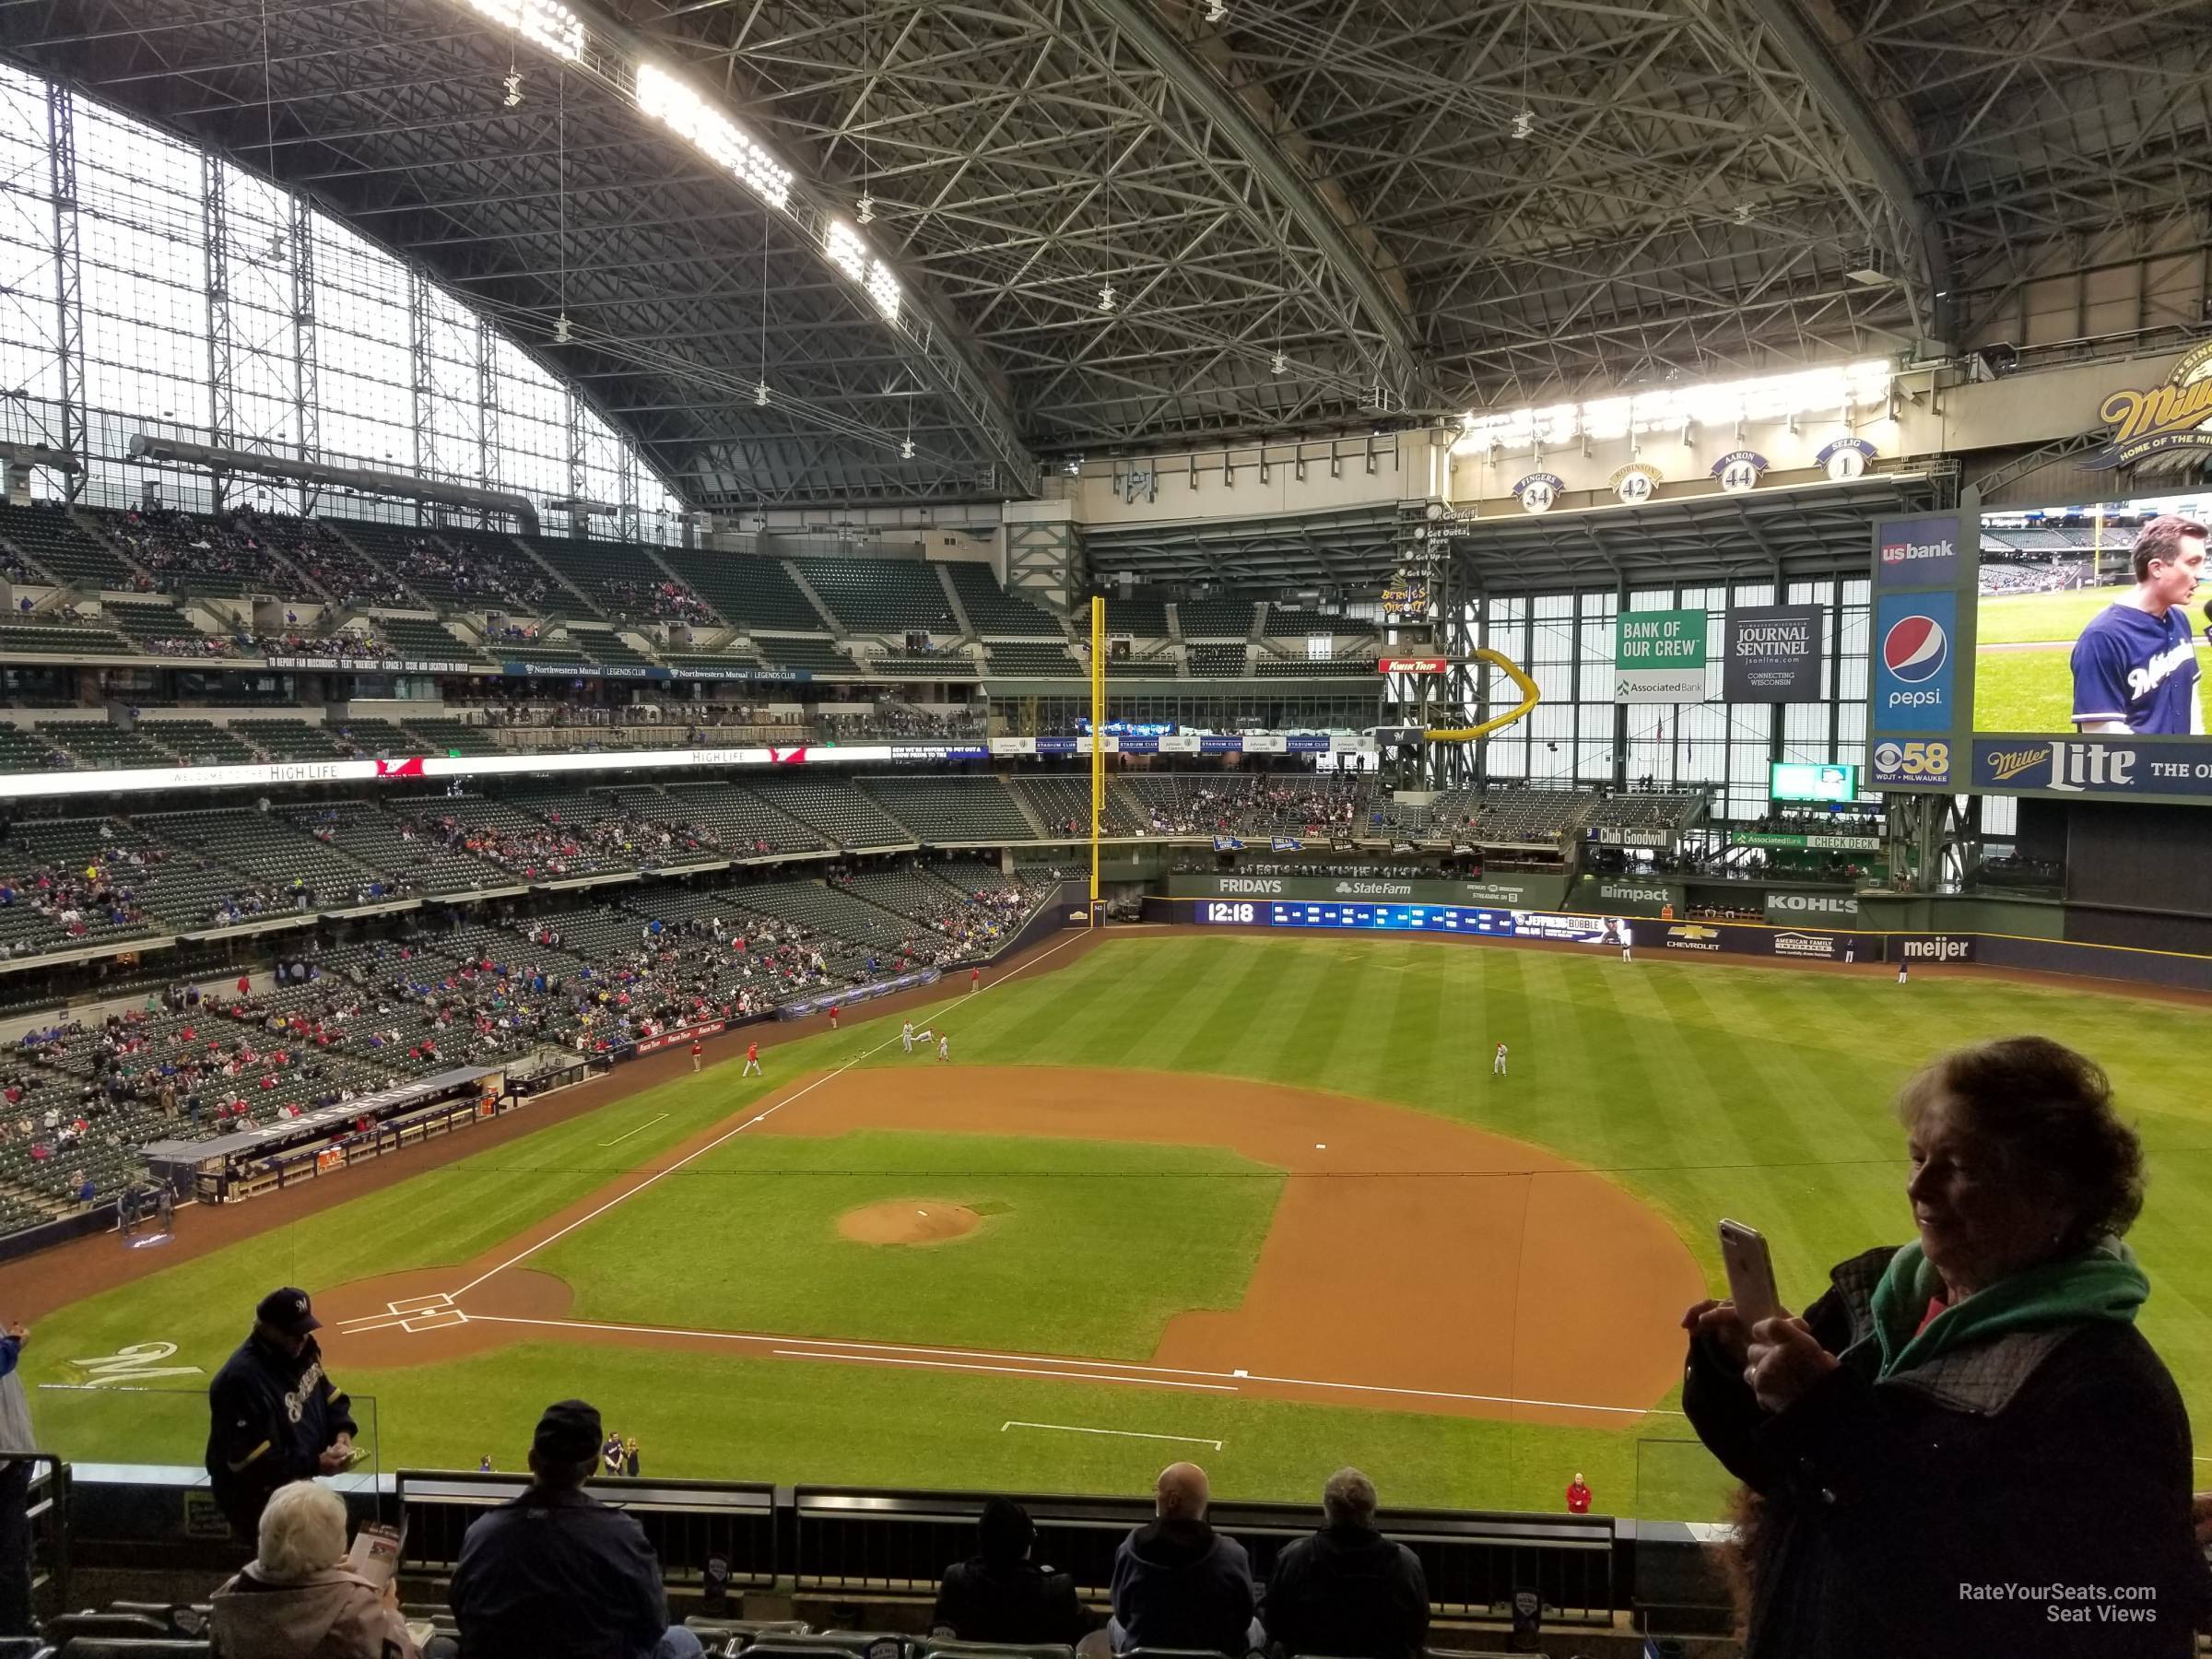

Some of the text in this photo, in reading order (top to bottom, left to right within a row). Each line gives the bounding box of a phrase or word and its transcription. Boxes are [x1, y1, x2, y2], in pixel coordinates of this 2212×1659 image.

[1830, 439, 1862, 450] SELIG
[2120, 443, 2150, 461] HOME
[2152, 437, 2168, 447] OF
[2171, 435, 2194, 443] THE
[1724, 452, 1756, 464] AARON
[1613, 465, 1657, 480] ROBINSON
[1840, 457, 1852, 477] 1
[1521, 473, 1558, 486] FINGERS
[1724, 467, 1752, 487] 44
[1622, 478, 1648, 498] 42
[1526, 488, 1550, 506] 34
[1382, 584, 1427, 601] BERNIE'S
[1382, 600, 1426, 615] DUGOUT
[1623, 621, 1681, 639] BANK OF
[1736, 627, 1810, 643] JOURNAL
[1623, 640, 1697, 657] OUR CREW
[1736, 641, 1809, 656] SENTINEL
[341, 659, 352, 668] TEXT
[1388, 661, 1436, 671] KWIK TRIP
[1746, 657, 1800, 665] jsonline.com
[534, 665, 646, 677] Northwestern Mutual LEGENDS CLUB
[679, 669, 796, 679] Northwestern Mutual LEGENDS CLUB
[1889, 688, 1941, 708] pepsi
[693, 751, 745, 762] HIGH LIFE
[1901, 743, 1949, 775] 58
[271, 765, 338, 781] HIGH LIFE
[1987, 747, 2051, 780] Miller
[2045, 741, 2136, 792] Lite
[2151, 762, 2190, 778] THE
[1902, 774, 1947, 782] MILWAUKEE
[1600, 829, 1667, 845] Club Goodwill
[1815, 837, 1874, 848] CHECK DECK
[1219, 878, 1282, 893] FRIDAYS
[1614, 885, 1669, 901] impact
[1208, 902, 1254, 922] 12:18
[1768, 895, 1858, 913] KOHL'S
[1568, 918, 1599, 929] BOBBLE
[1666, 941, 1720, 950] CHEVROLET
[1903, 936, 1969, 961] meijer
